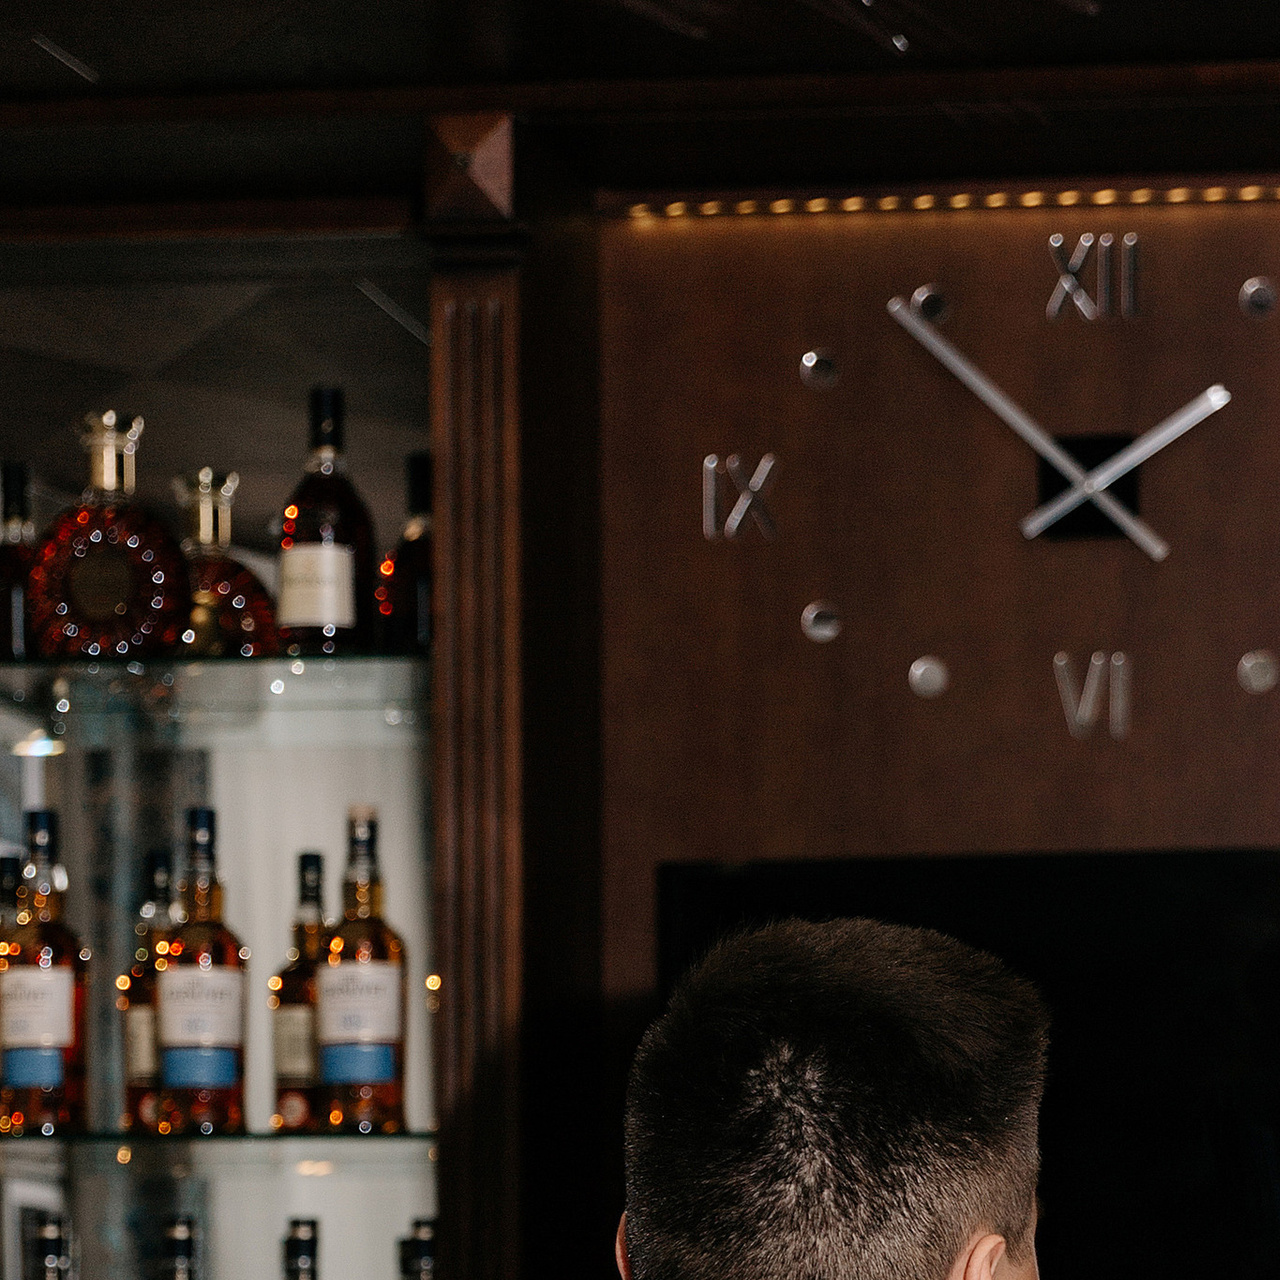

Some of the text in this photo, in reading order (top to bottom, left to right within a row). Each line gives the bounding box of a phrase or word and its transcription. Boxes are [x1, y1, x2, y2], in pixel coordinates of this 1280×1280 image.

[1045, 231, 1139, 321] XII
[701, 451, 779, 541] IX
[1052, 650, 1134, 741] VI
